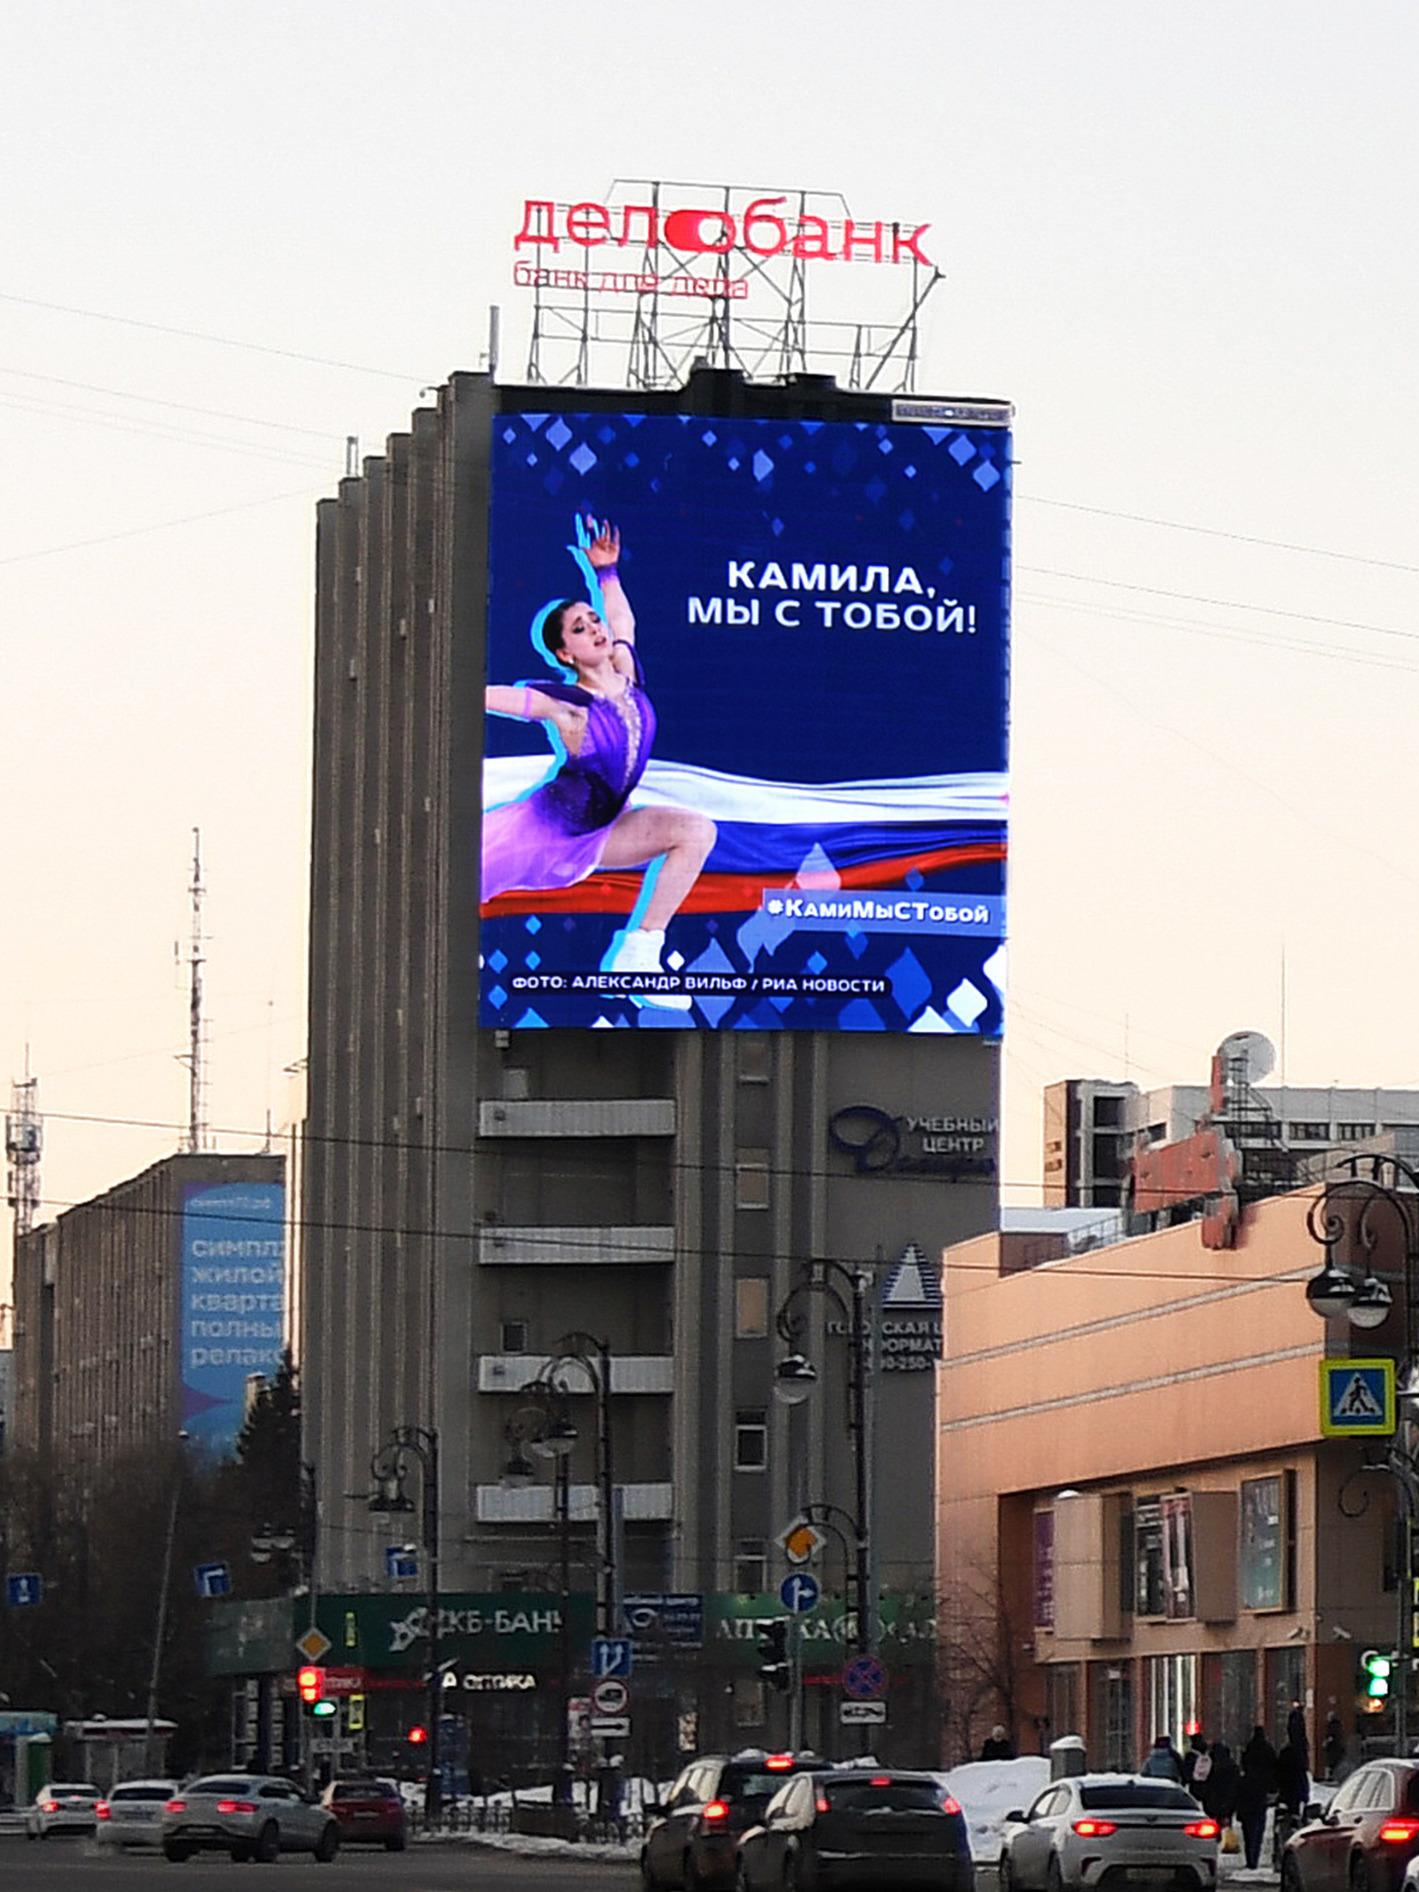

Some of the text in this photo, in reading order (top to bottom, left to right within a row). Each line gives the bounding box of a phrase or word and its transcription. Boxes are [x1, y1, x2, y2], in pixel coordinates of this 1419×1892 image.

[728, 560, 936, 599] КАМИЛА,
[688, 597, 977, 634] МЫ С ТОБОЙ!
[512, 976, 567, 989] ФОТО:
[572, 976, 680, 990] АЛЕКСАНДР
[685, 977, 747, 990] ВИЛЬФ
[762, 978, 798, 991] РИА
[803, 979, 885, 992] НОВОСТИ
[923, 1136, 984, 1153] ЦЕНТР
